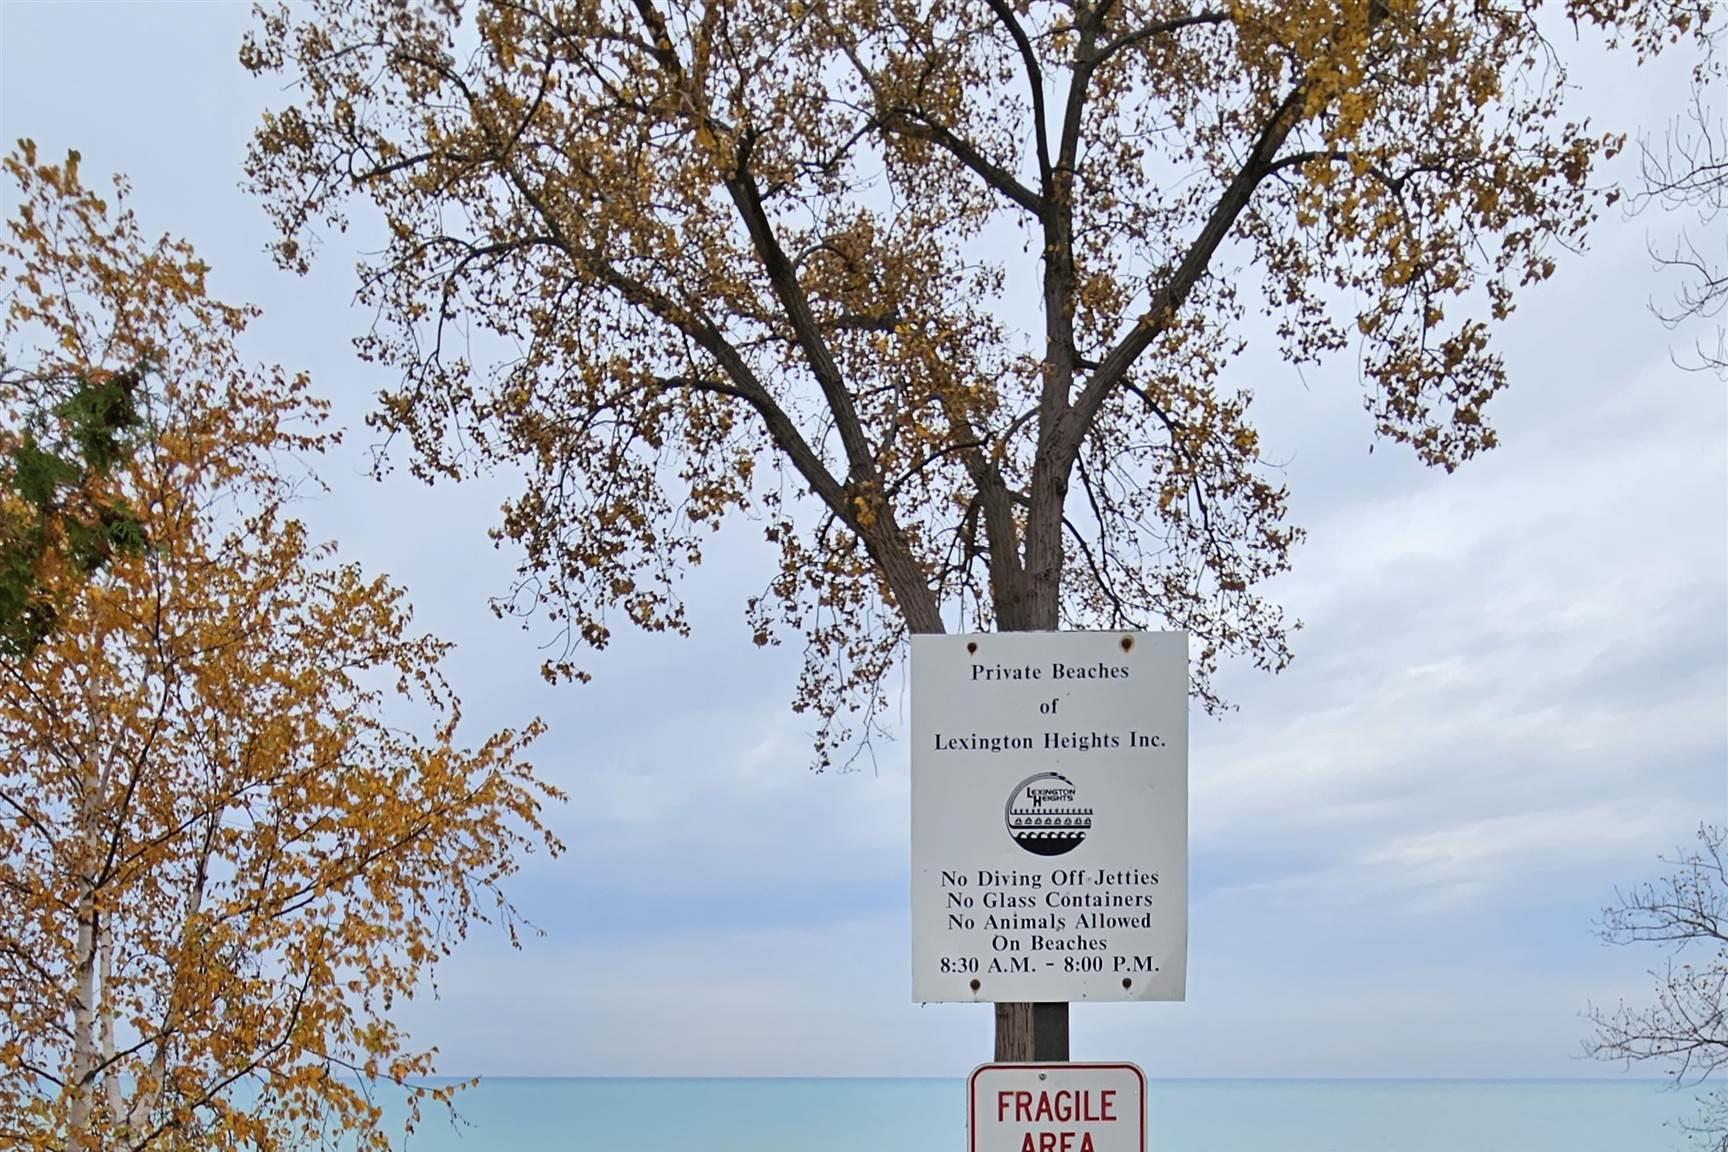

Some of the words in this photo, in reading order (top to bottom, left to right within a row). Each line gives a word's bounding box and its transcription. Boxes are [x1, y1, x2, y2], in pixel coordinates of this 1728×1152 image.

[970, 663, 1042, 681] Private
[1052, 662, 1130, 680] Beaches
[1039, 698, 1060, 715] of
[935, 733, 1034, 753] Lexington
[1044, 732, 1120, 752] Heights
[1129, 731, 1167, 748] Inc.
[941, 870, 968, 887] No
[977, 870, 1042, 889] Diving
[1051, 869, 1086, 886] Off
[1094, 868, 1159, 886] Jetties
[946, 892, 974, 909] No
[982, 892, 1037, 909] Glass
[1045, 891, 1153, 908] Containers
[948, 914, 975, 931] No
[983, 913, 1067, 930] Animals
[1074, 912, 1152, 930] Allowed
[991, 935, 1020, 952] On
[1030, 935, 1107, 952] Beaches
[940, 957, 979, 974] 8:30
[987, 956, 1036, 974] A.M.
[1063, 955, 1103, 973] 8:00
[1112, 955, 1160, 973] P.M.
[997, 1090, 1118, 1123] FRAGILE
